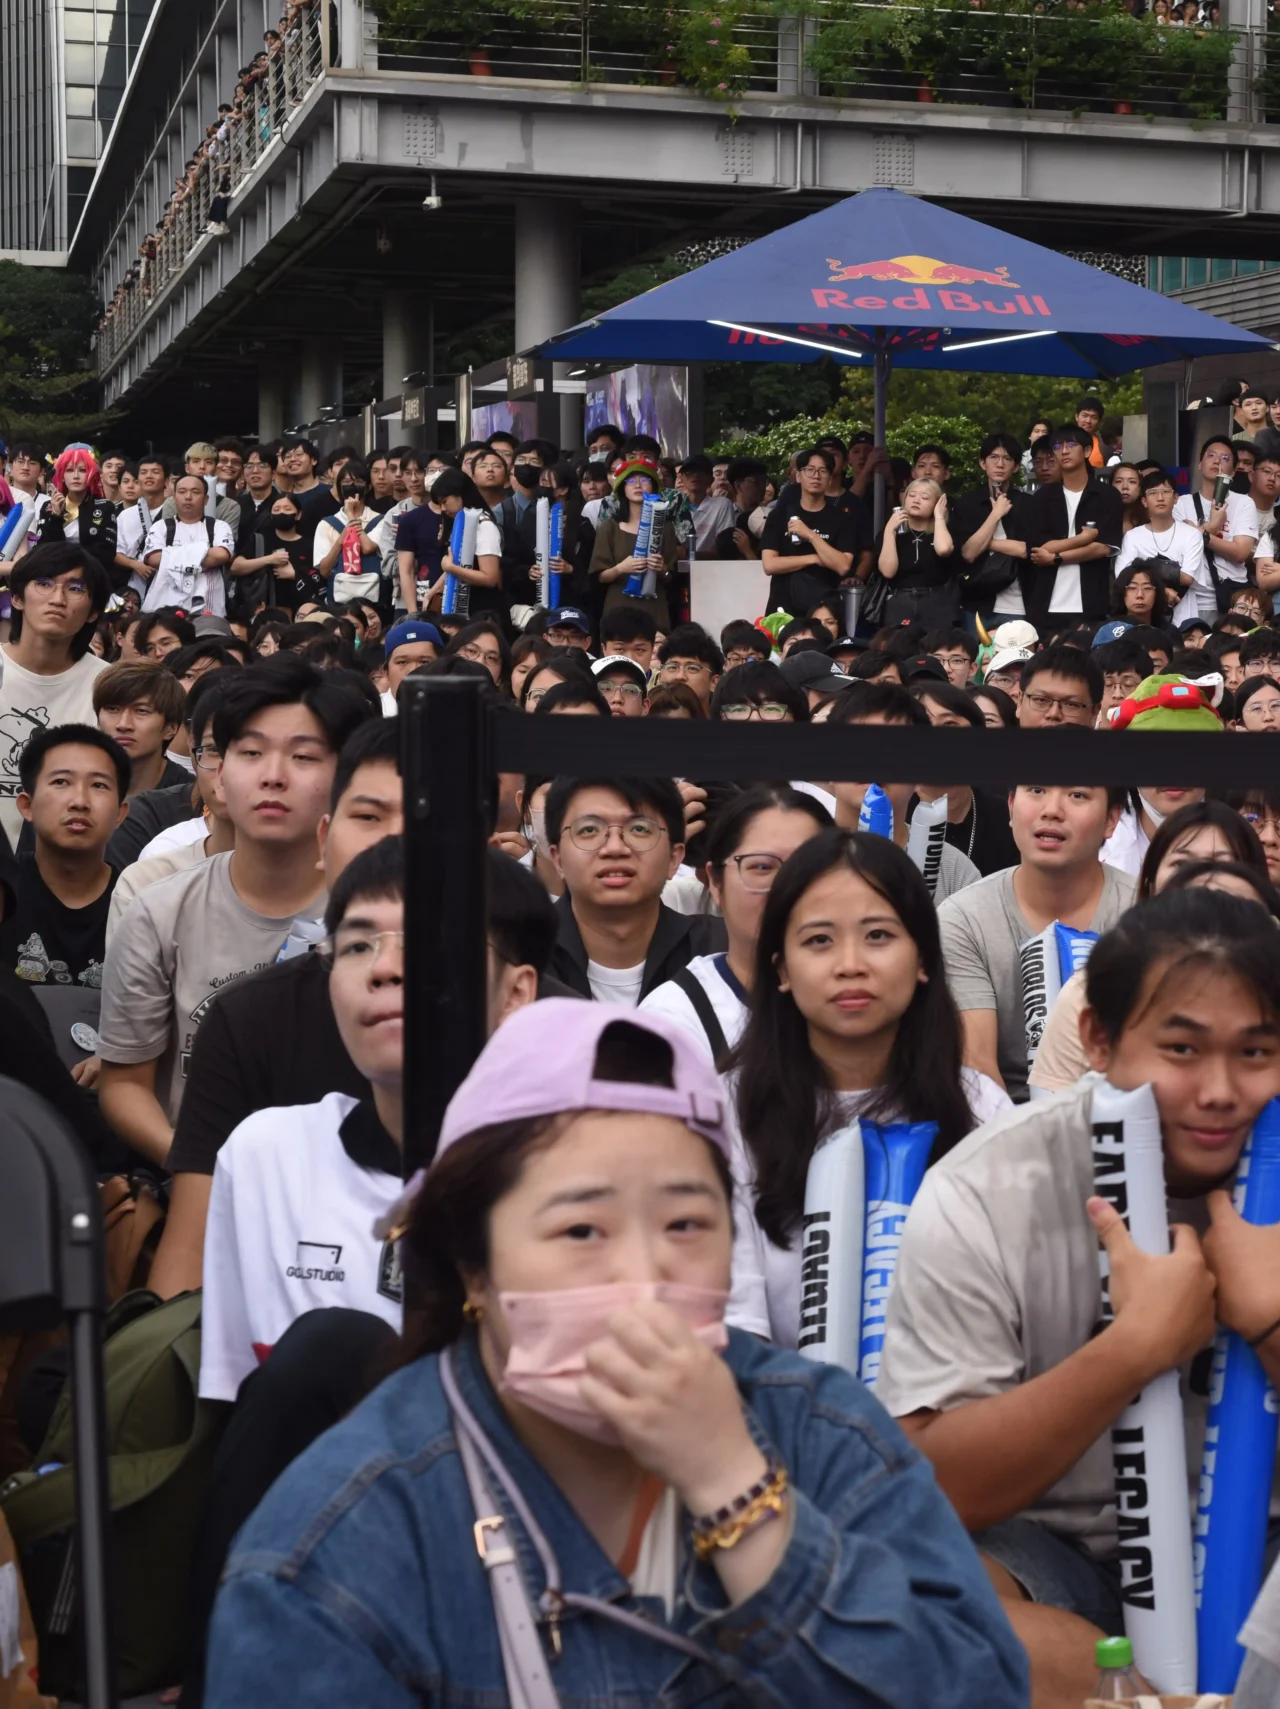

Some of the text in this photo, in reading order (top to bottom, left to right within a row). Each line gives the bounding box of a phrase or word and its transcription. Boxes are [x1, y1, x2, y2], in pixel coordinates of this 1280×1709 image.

[810, 288, 1052, 316] Red Bull
[635, 525, 650, 549] YOUR
[650, 509, 666, 555] WORLDS 25
[209, 969, 247, 989] Custom
[1020, 938, 1048, 1022] WORLDS
[1111, 1426, 1156, 1611] LEGACY
